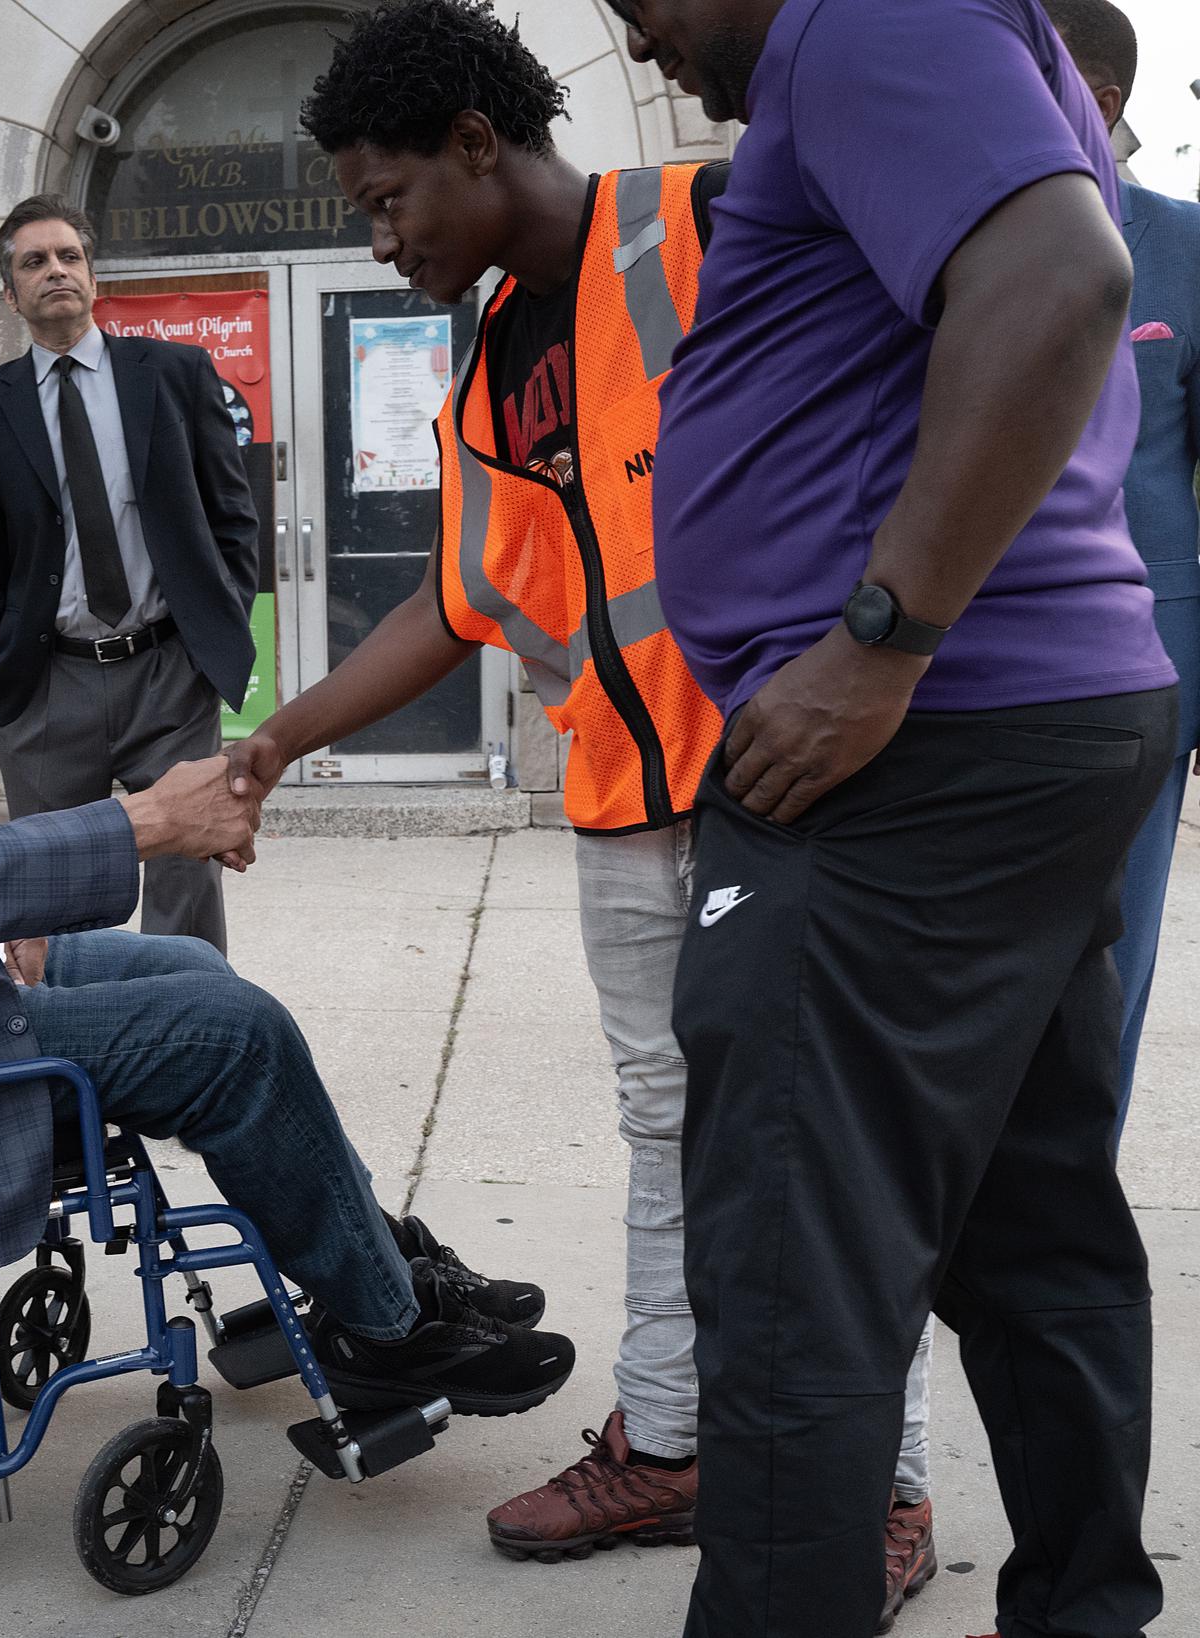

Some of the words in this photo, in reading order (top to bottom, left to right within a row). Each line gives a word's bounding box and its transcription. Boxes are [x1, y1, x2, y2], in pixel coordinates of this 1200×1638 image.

[176, 159, 248, 190] M.B.
[109, 196, 356, 242] FELLOWSHIP
[104, 319, 145, 338] New
[147, 317, 194, 341] Mount
[196, 315, 253, 343] Pilgrim
[214, 344, 253, 360] Church
